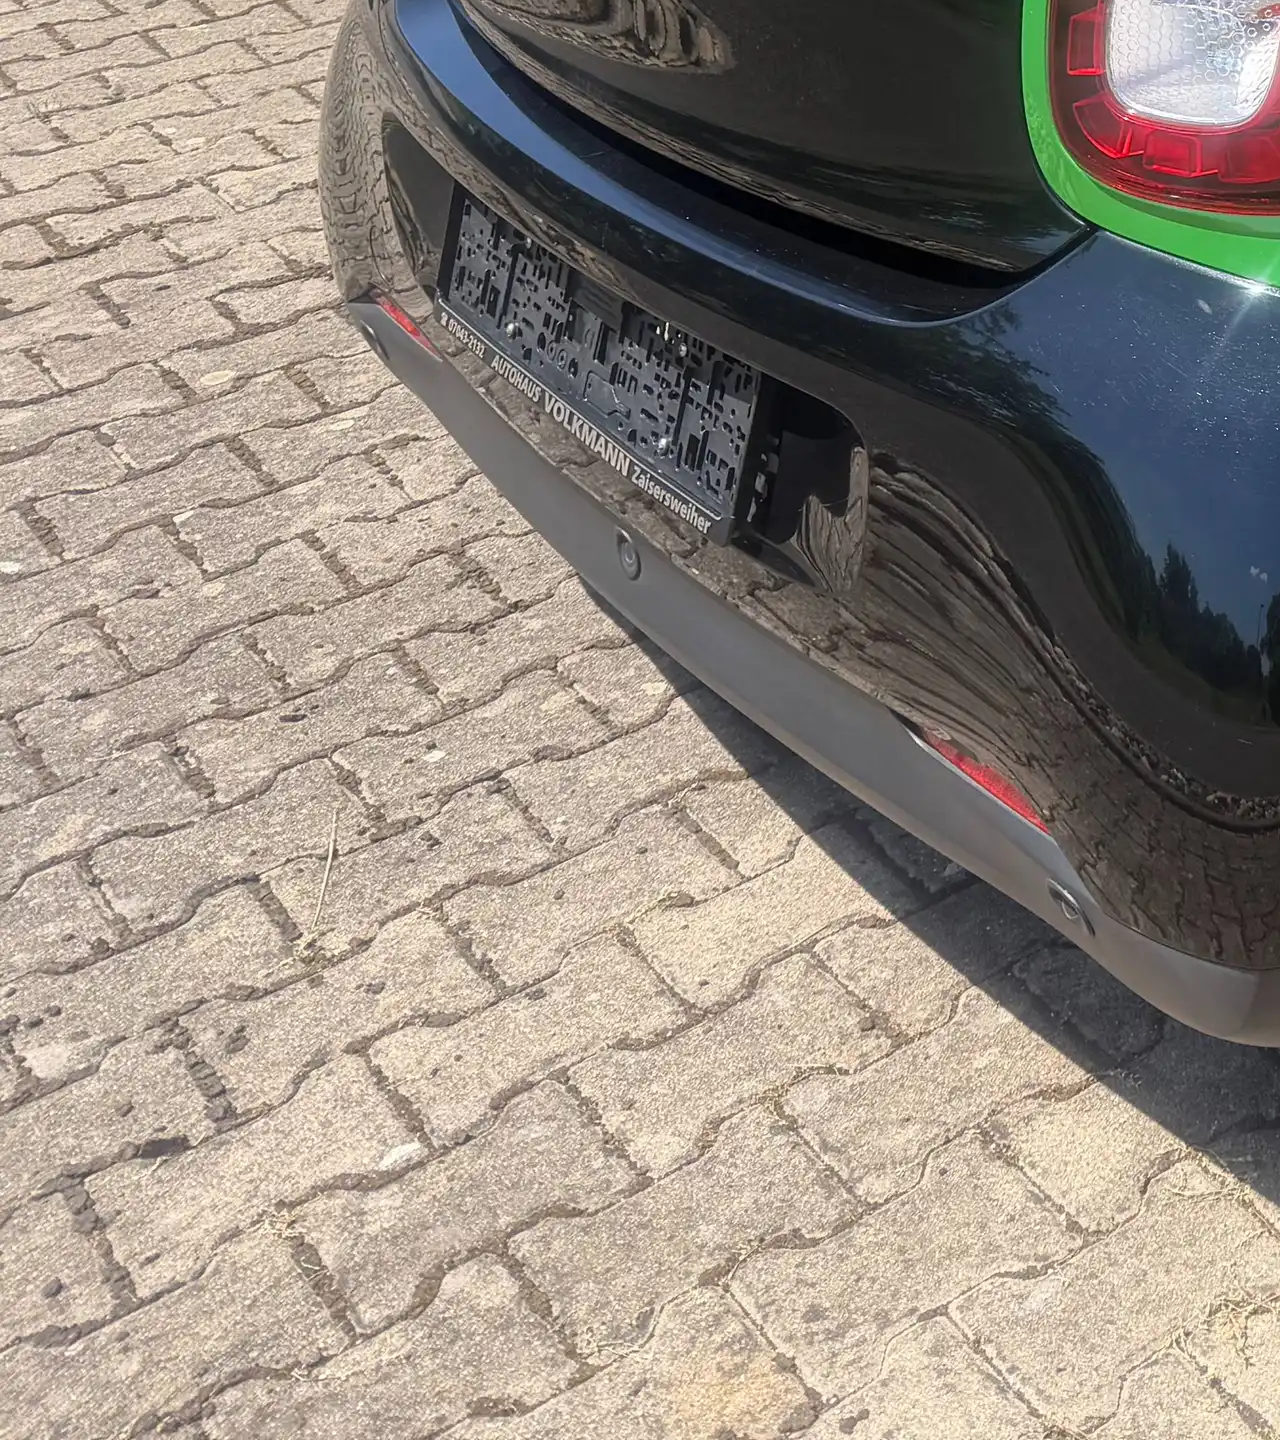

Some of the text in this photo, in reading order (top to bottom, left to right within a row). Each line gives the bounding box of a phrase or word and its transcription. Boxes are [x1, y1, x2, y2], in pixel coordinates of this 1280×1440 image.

[448, 317, 712, 535] 07043-2132 AUTOHAUS VOLKMANN Zaisersweiher
